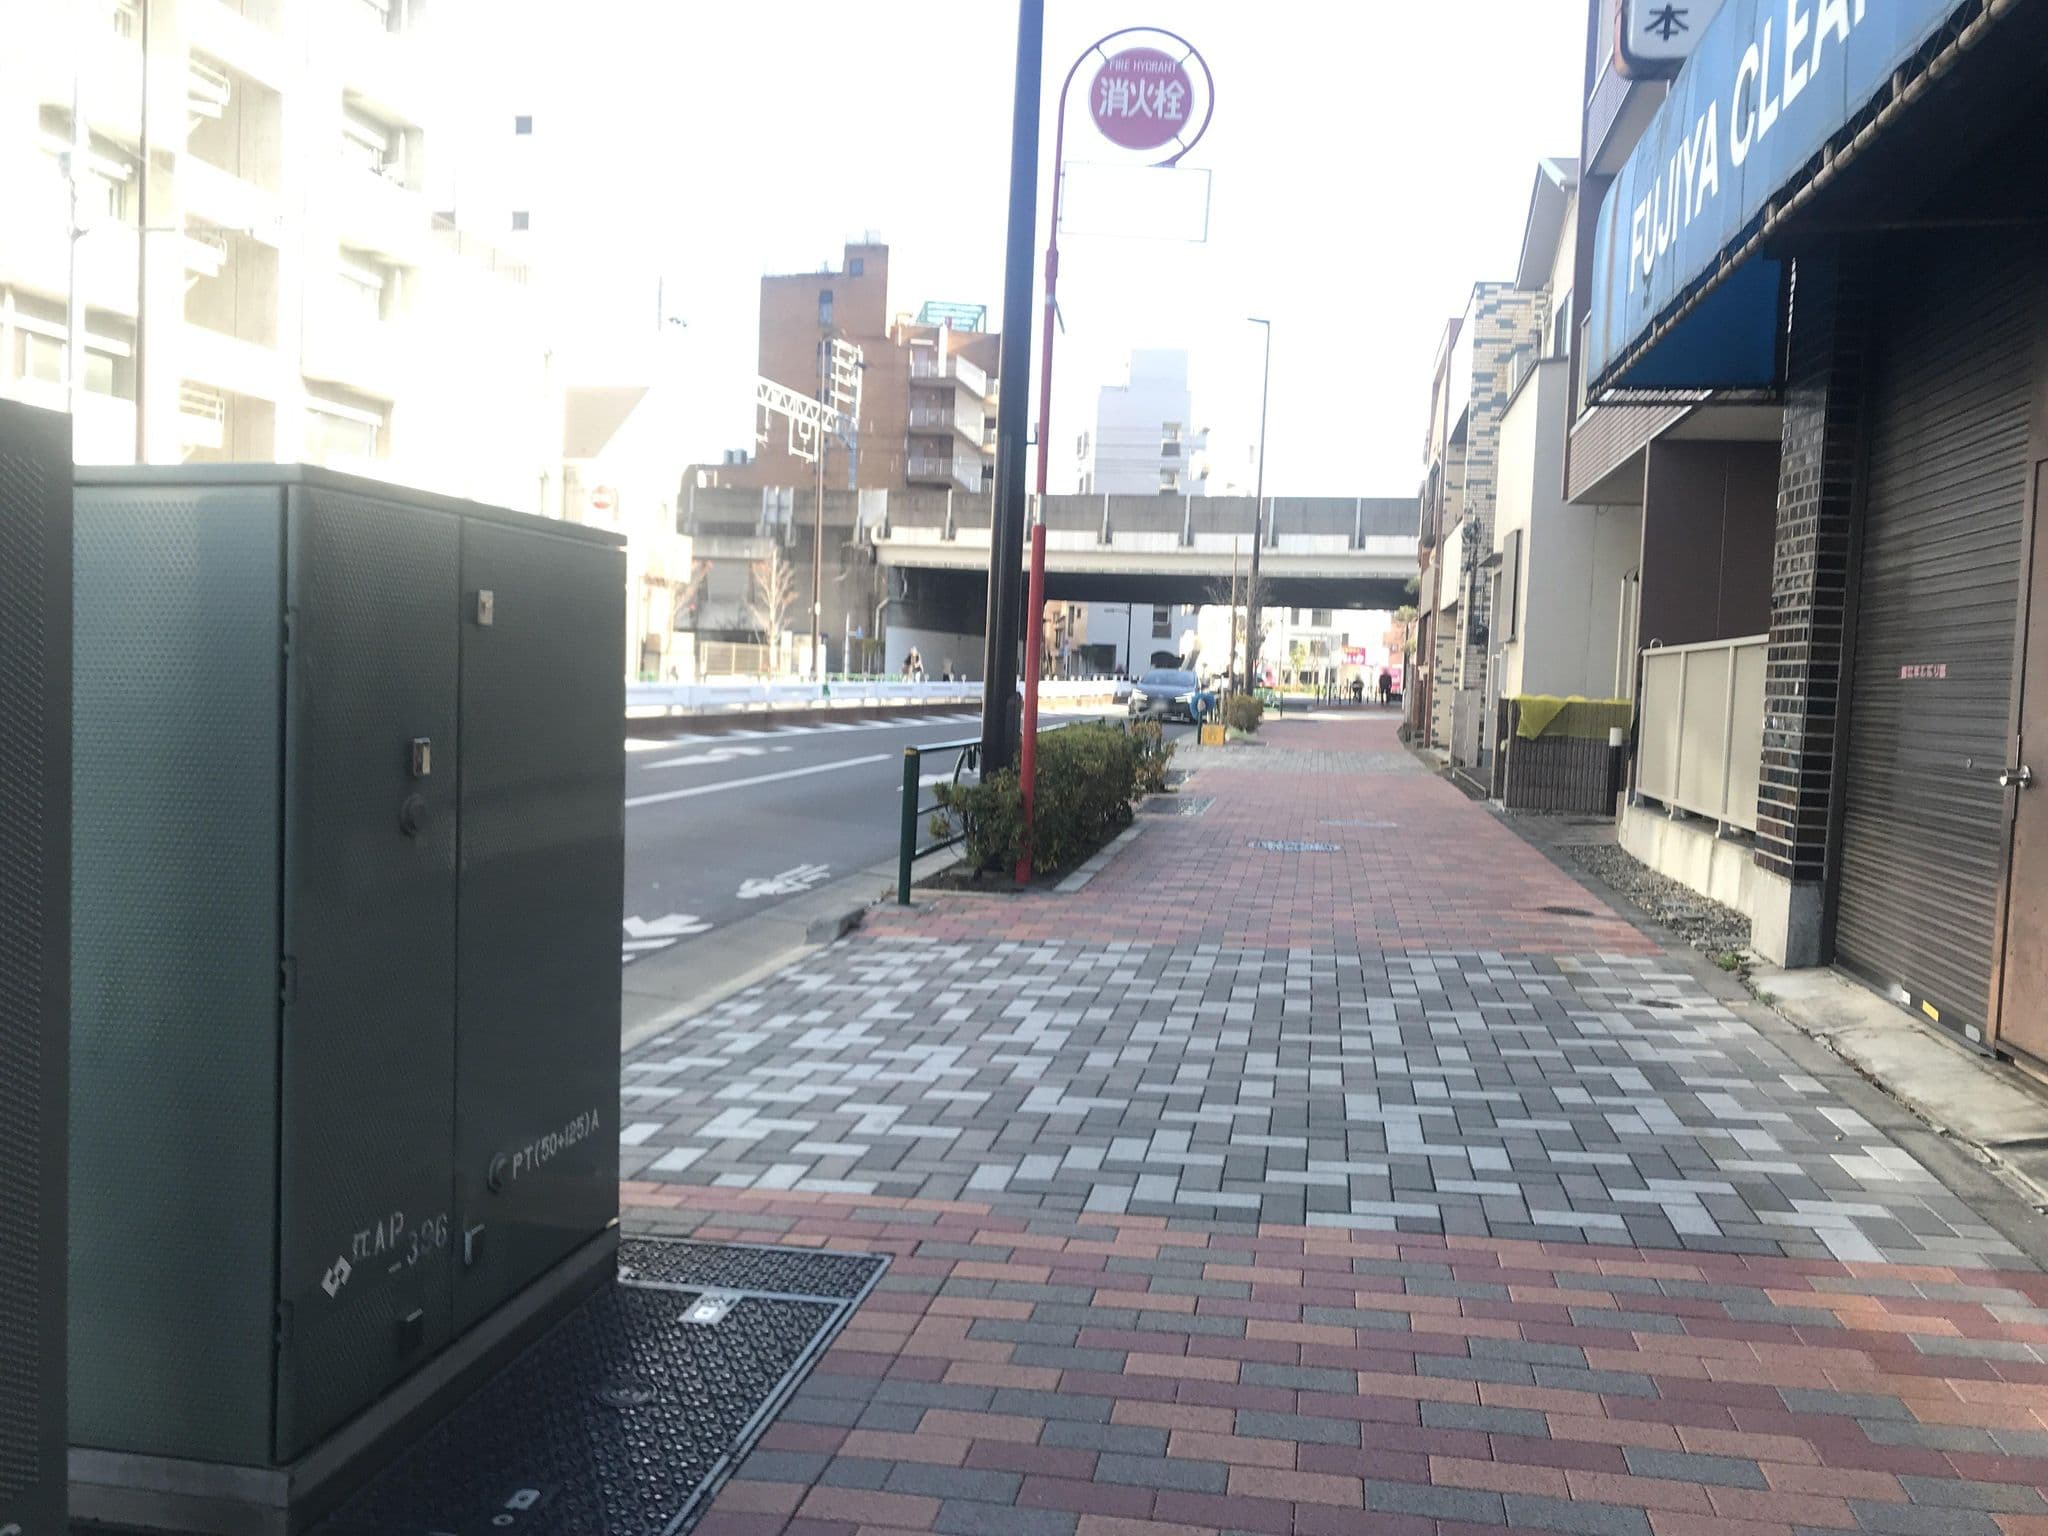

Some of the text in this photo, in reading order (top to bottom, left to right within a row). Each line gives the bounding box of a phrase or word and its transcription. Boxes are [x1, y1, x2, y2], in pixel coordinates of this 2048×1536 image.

[1644, 3, 1689, 42] 本
[1108, 58, 1177, 73] FIRE HYDRANT
[1099, 77, 1185, 119] 消火栓
[1629, 97, 1719, 296] FUJIYA
